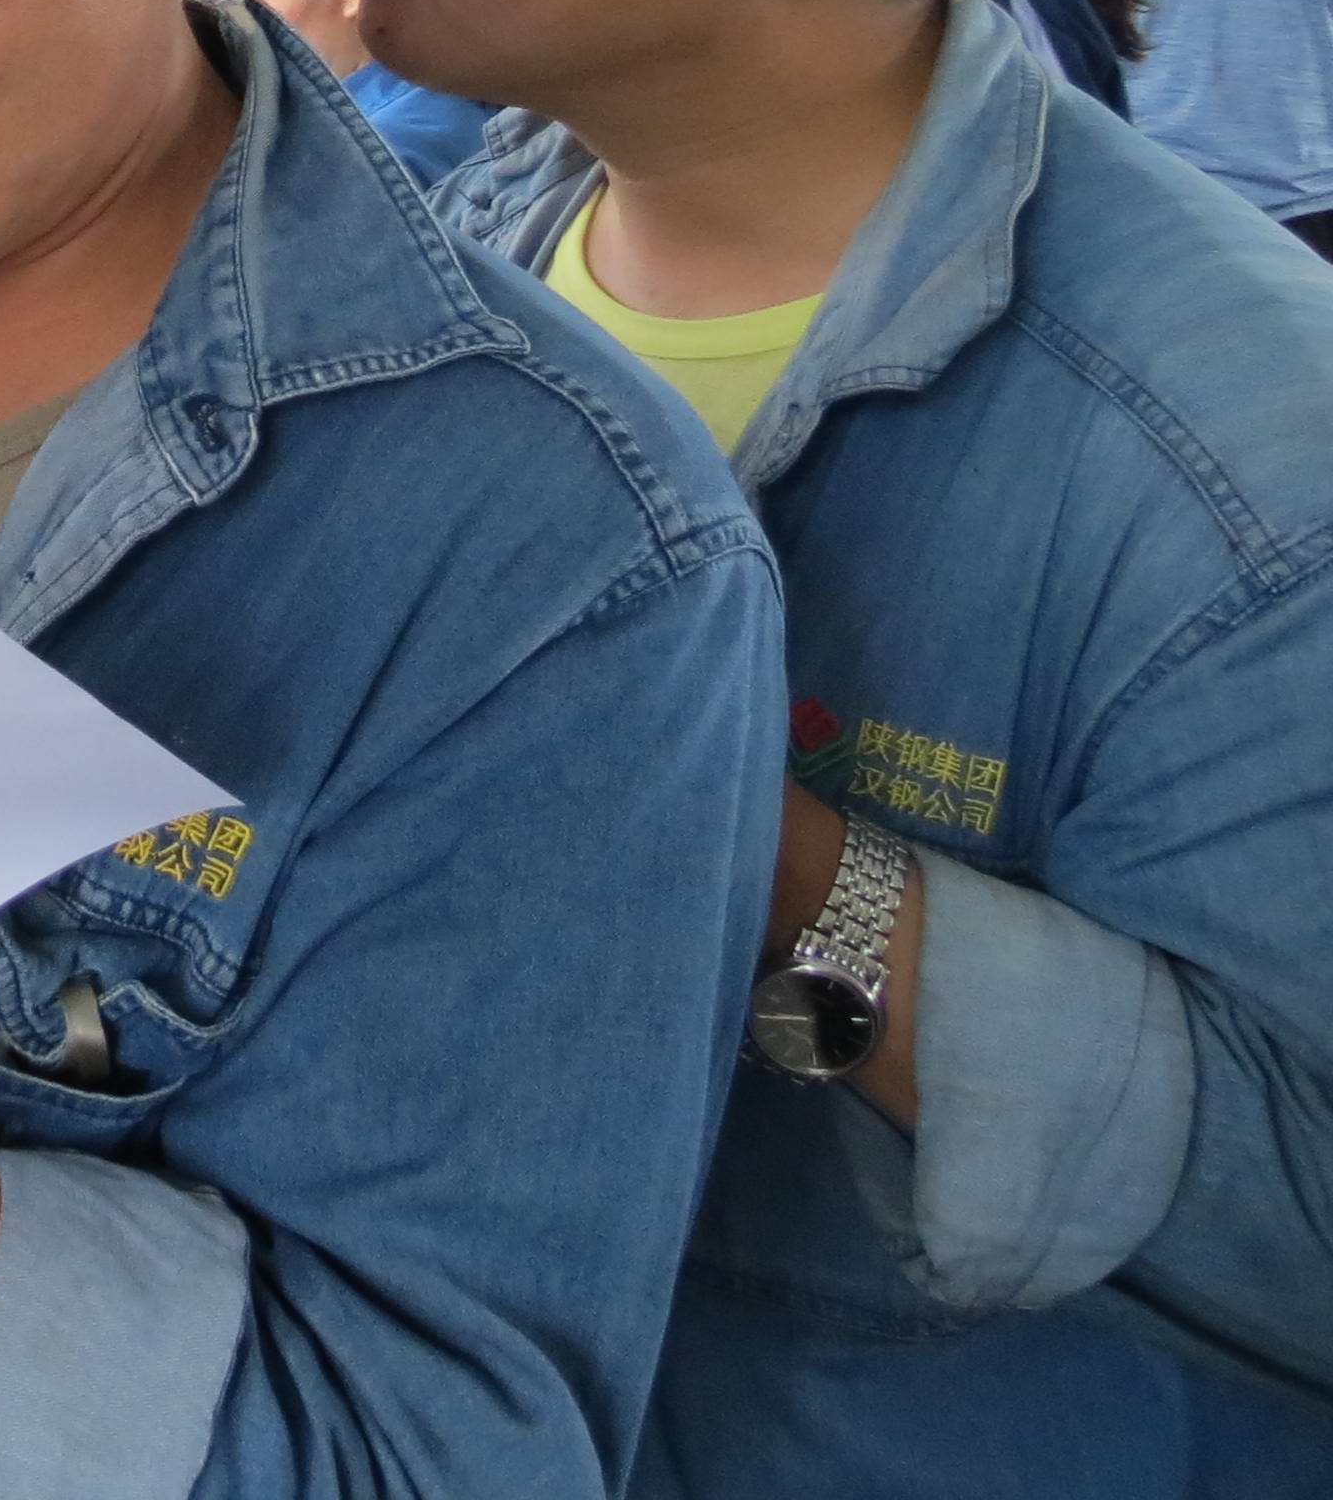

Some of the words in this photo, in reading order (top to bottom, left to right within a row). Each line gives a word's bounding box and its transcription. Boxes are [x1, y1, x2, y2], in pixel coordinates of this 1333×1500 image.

[856, 717, 1008, 798] 陕钢集团
[847, 760, 996, 836] 汉钢公司
